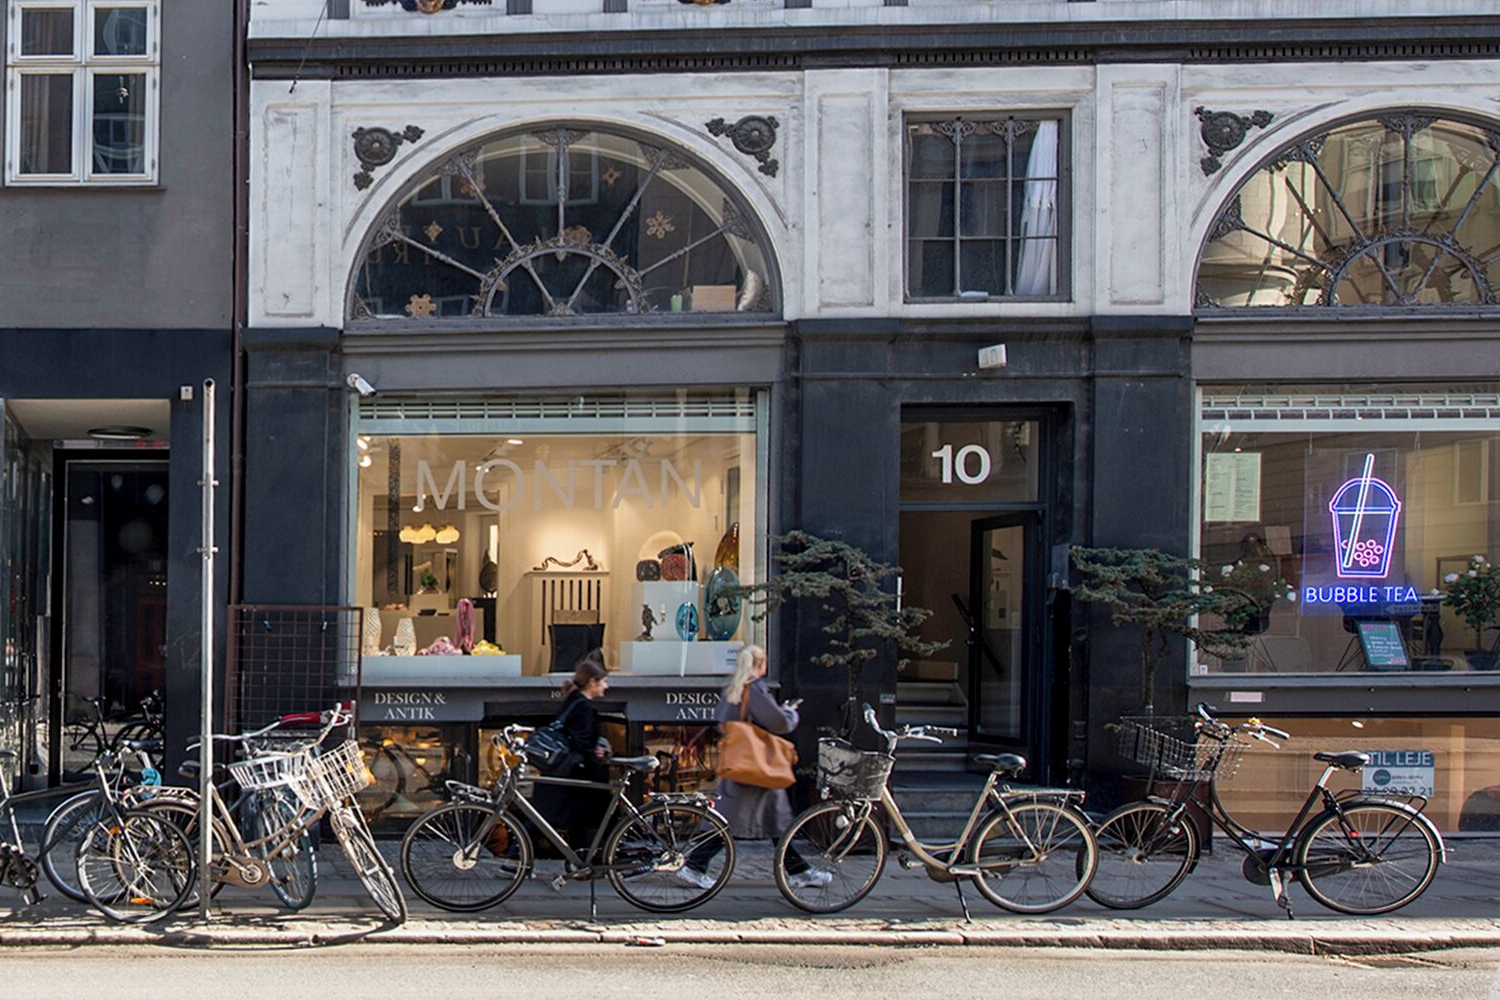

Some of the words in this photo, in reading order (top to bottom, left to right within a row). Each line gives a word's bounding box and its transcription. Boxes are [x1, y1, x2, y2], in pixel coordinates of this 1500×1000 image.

[931, 444, 991, 485] 10
[416, 458, 701, 512] MONTAN
[1305, 586, 1379, 604] BUBBLE
[1384, 586, 1418, 603] TEA
[374, 693, 432, 705] DESIGN
[434, 693, 447, 704] &
[666, 692, 722, 705] DESIGN
[384, 707, 436, 720] ANTIK
[675, 707, 716, 720] ANTI
[1366, 751, 1392, 766] TIL
[1395, 751, 1431, 766] LEJE
